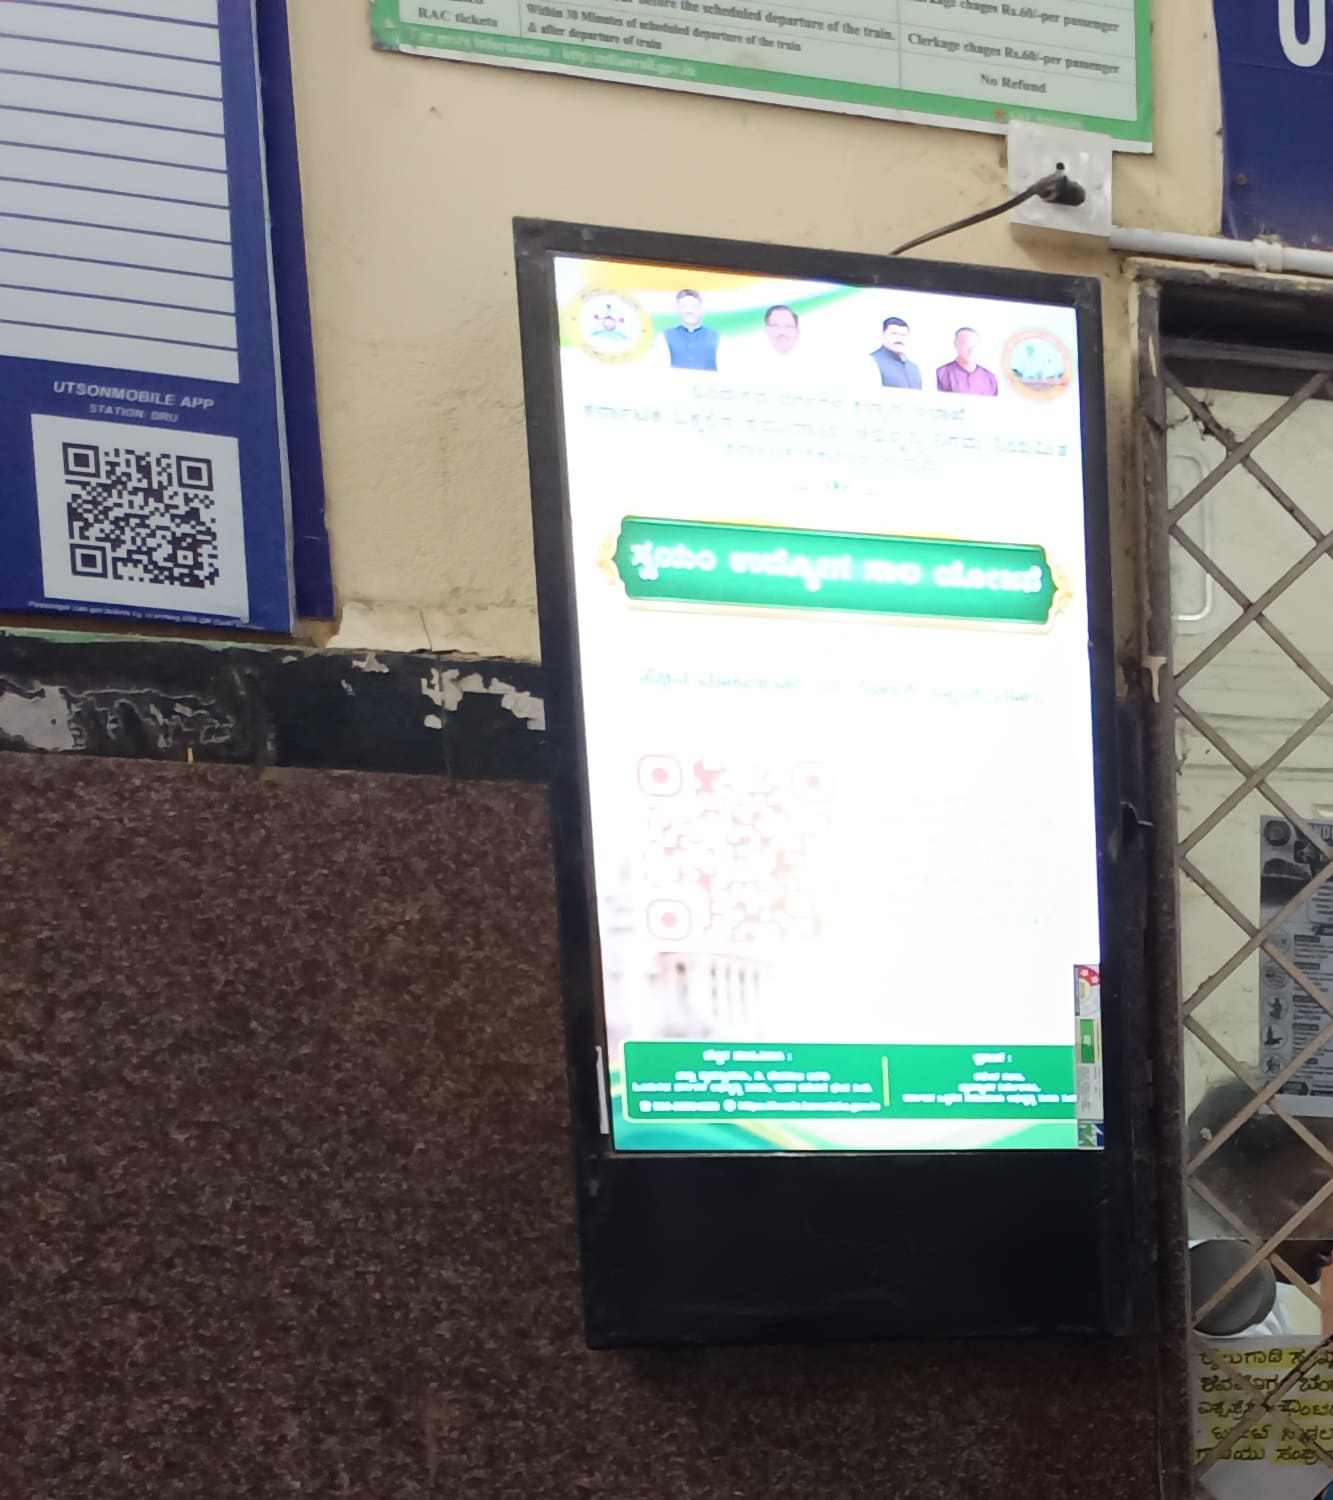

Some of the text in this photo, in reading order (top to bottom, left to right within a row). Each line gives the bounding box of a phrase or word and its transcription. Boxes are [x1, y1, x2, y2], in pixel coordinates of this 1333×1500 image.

[418, 7, 498, 28] RAC tickets
[827, 21, 839, 32] of
[843, 22, 860, 35] the
[980, 73, 1047, 93] No Refund
[53, 381, 215, 410] UTSONMOBILE APP
[89, 403, 144, 419] STATION
